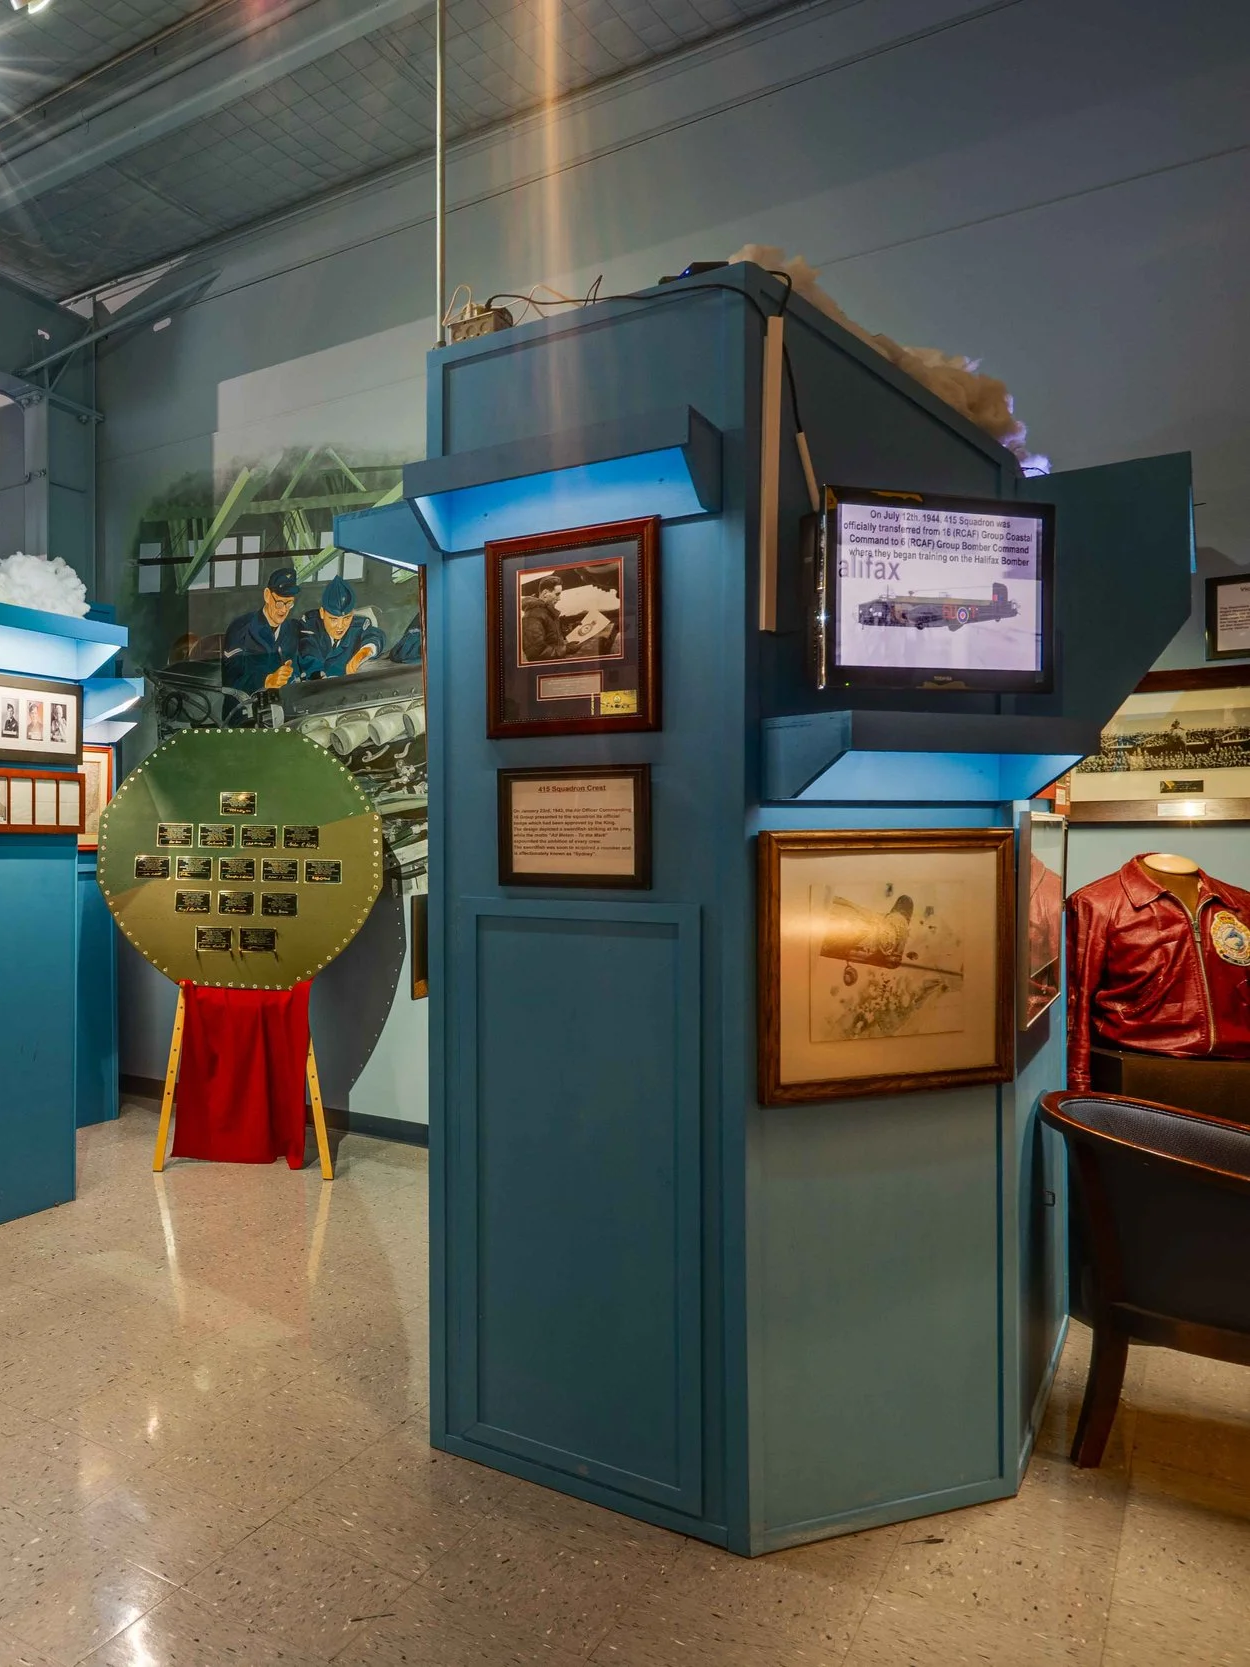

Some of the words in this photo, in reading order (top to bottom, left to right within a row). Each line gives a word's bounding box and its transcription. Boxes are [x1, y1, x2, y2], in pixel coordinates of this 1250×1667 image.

[870, 509, 882, 519] On
[884, 510, 900, 522] July
[944, 515, 958, 524] 415
[958, 516, 994, 528] Squadron
[996, 520, 1011, 528] was
[843, 520, 877, 534] officially
[878, 524, 921, 534] transferred
[922, 526, 940, 536] from
[942, 528, 952, 537] 16
[952, 528, 980, 540] (RCAF)
[981, 530, 1004, 541] Group
[1005, 532, 1033, 542] Coastal
[849, 534, 889, 545] Command
[891, 538, 899, 546] to
[900, 537, 906, 546] 6
[907, 538, 935, 550] (RCAF)
[936, 539, 960, 551] Group
[961, 541, 990, 552] Bomber
[992, 544, 1030, 554] Command
[848, 547, 872, 558] where
[874, 548, 892, 560] they
[893, 549, 917, 561] began
[918, 551, 948, 564] training
[949, 554, 959, 562] on
[960, 554, 972, 563] the
[974, 554, 999, 565] Halifax
[1001, 556, 1030, 567] Bomber
[538, 785, 550, 793] 415
[551, 784, 586, 793] Squadron
